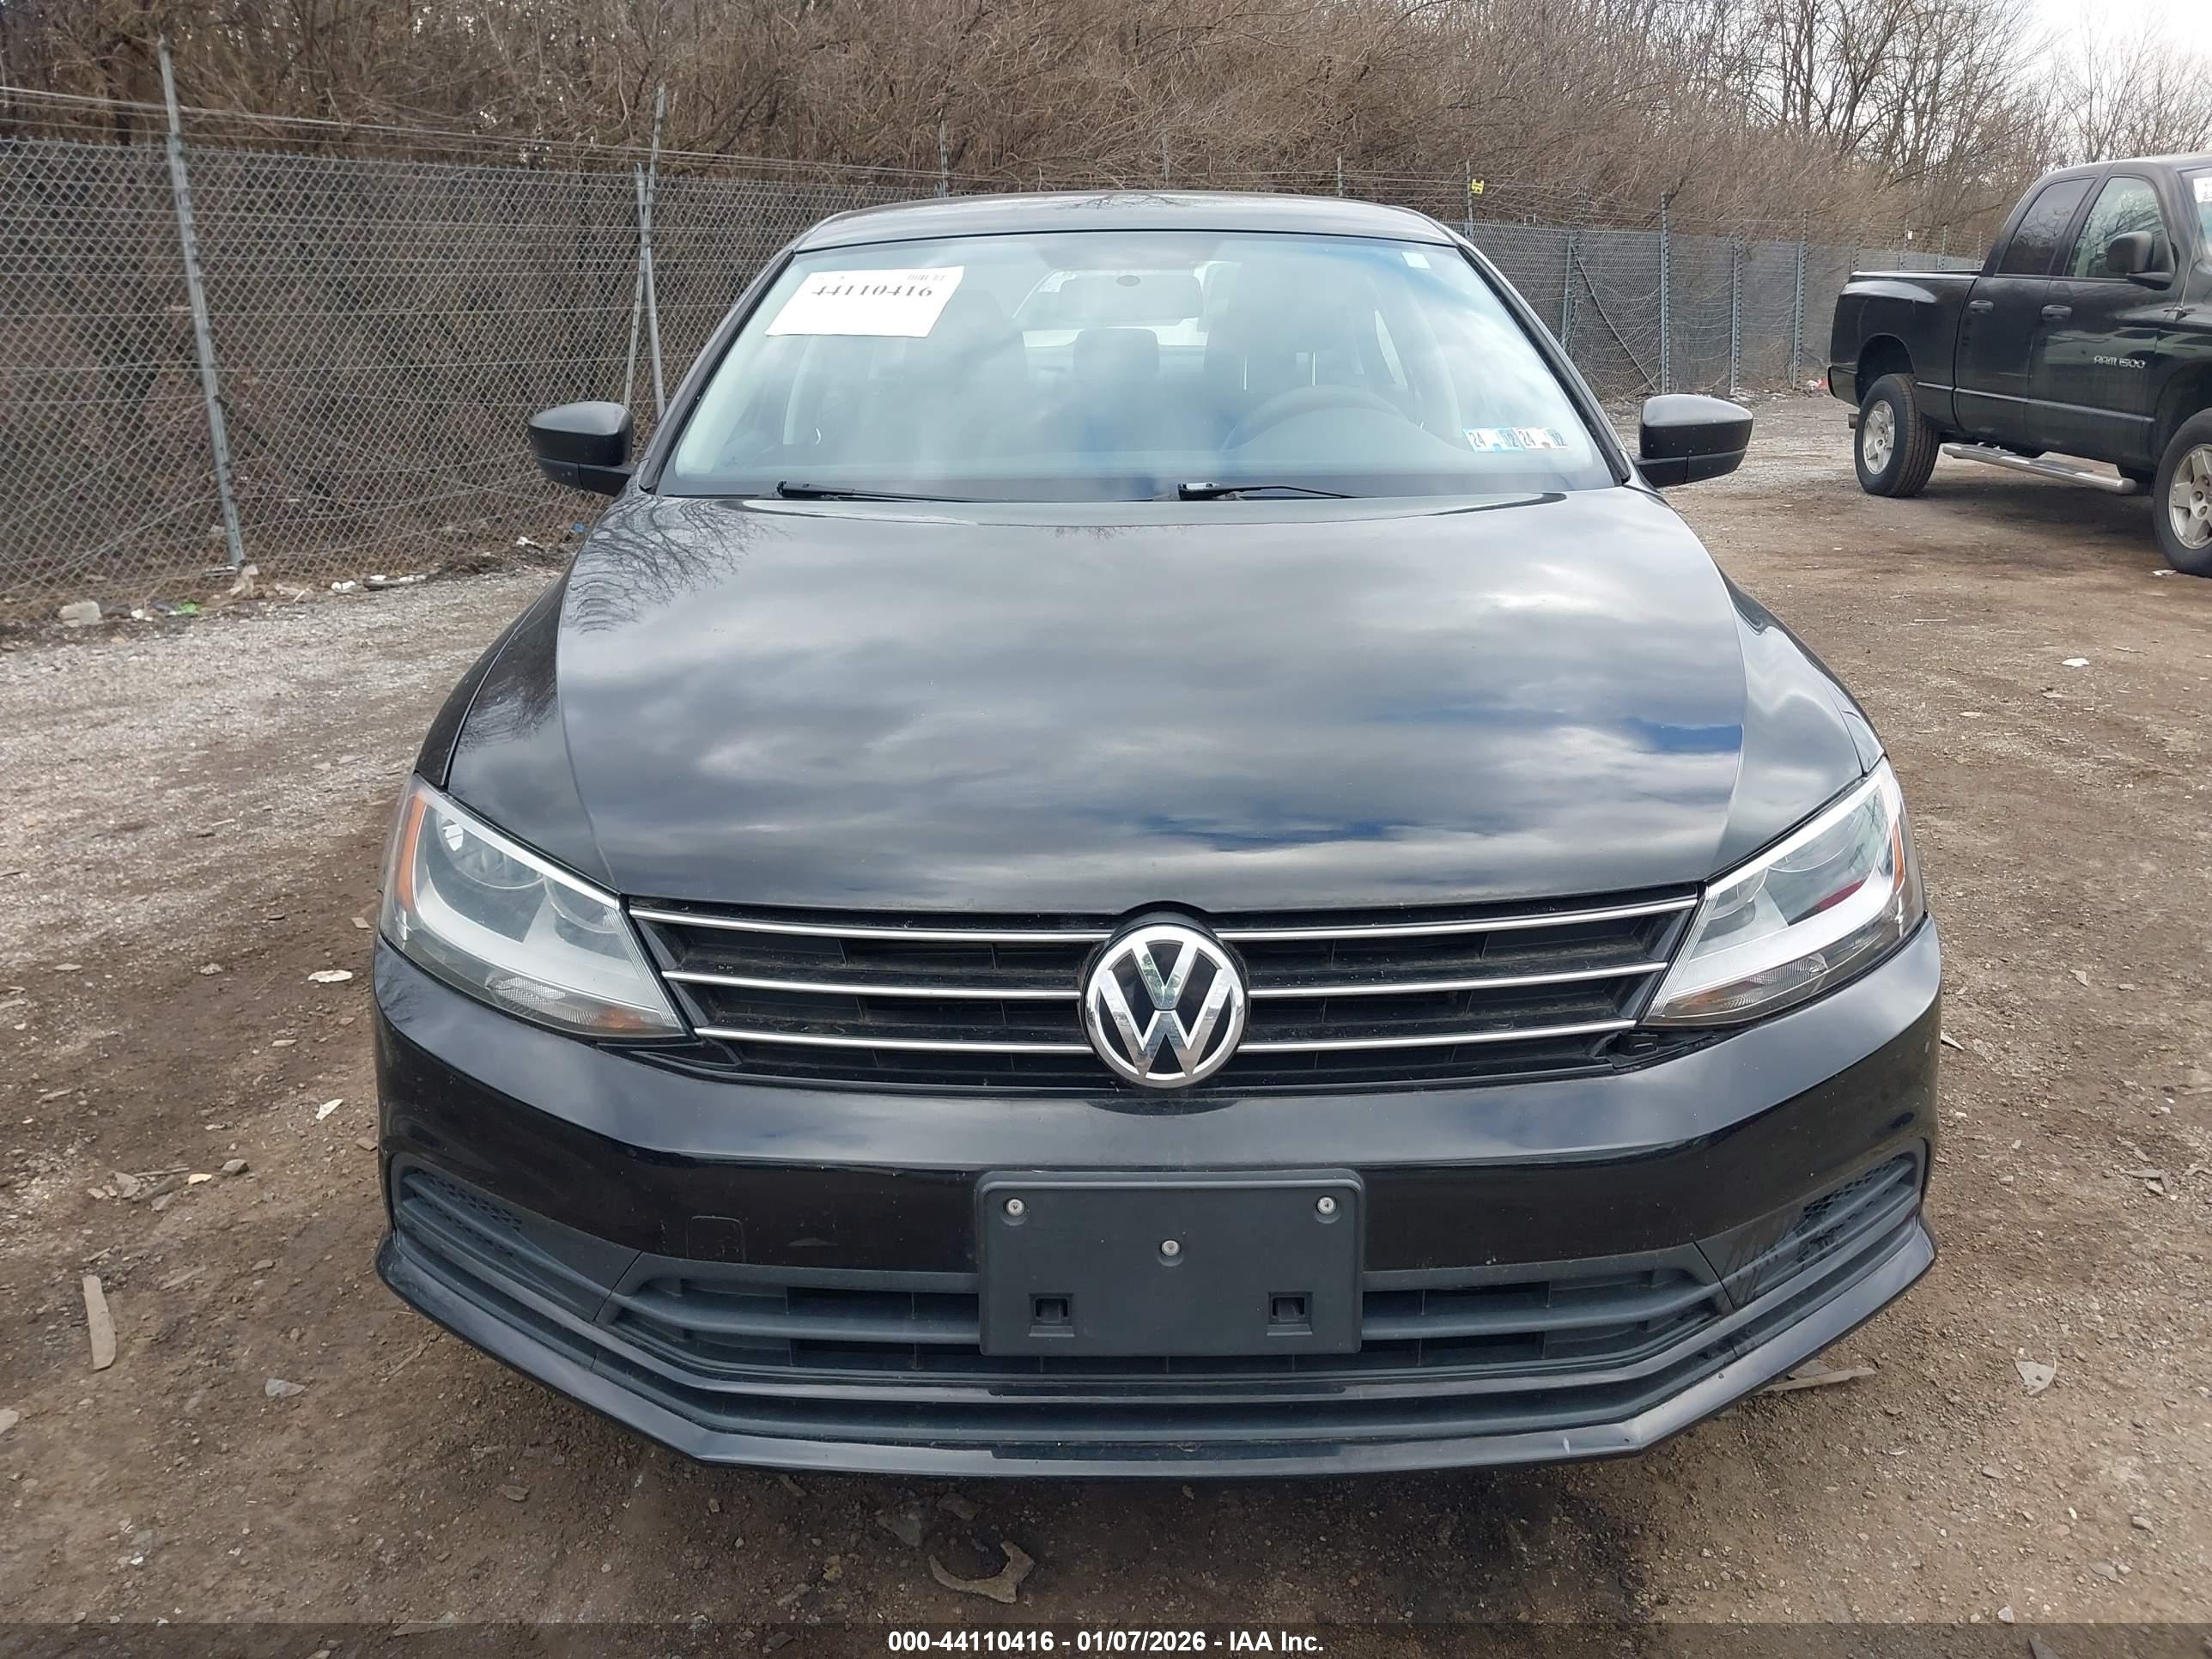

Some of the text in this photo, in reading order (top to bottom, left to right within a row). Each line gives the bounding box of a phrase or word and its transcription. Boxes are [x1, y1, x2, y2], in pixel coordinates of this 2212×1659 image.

[811, 284, 933, 296] 44110416
[2094, 355, 2146, 369] RAM 1500
[1468, 432, 1487, 447] 24
[1517, 430, 1536, 447] 24
[1087, 927, 1242, 1085] VW
